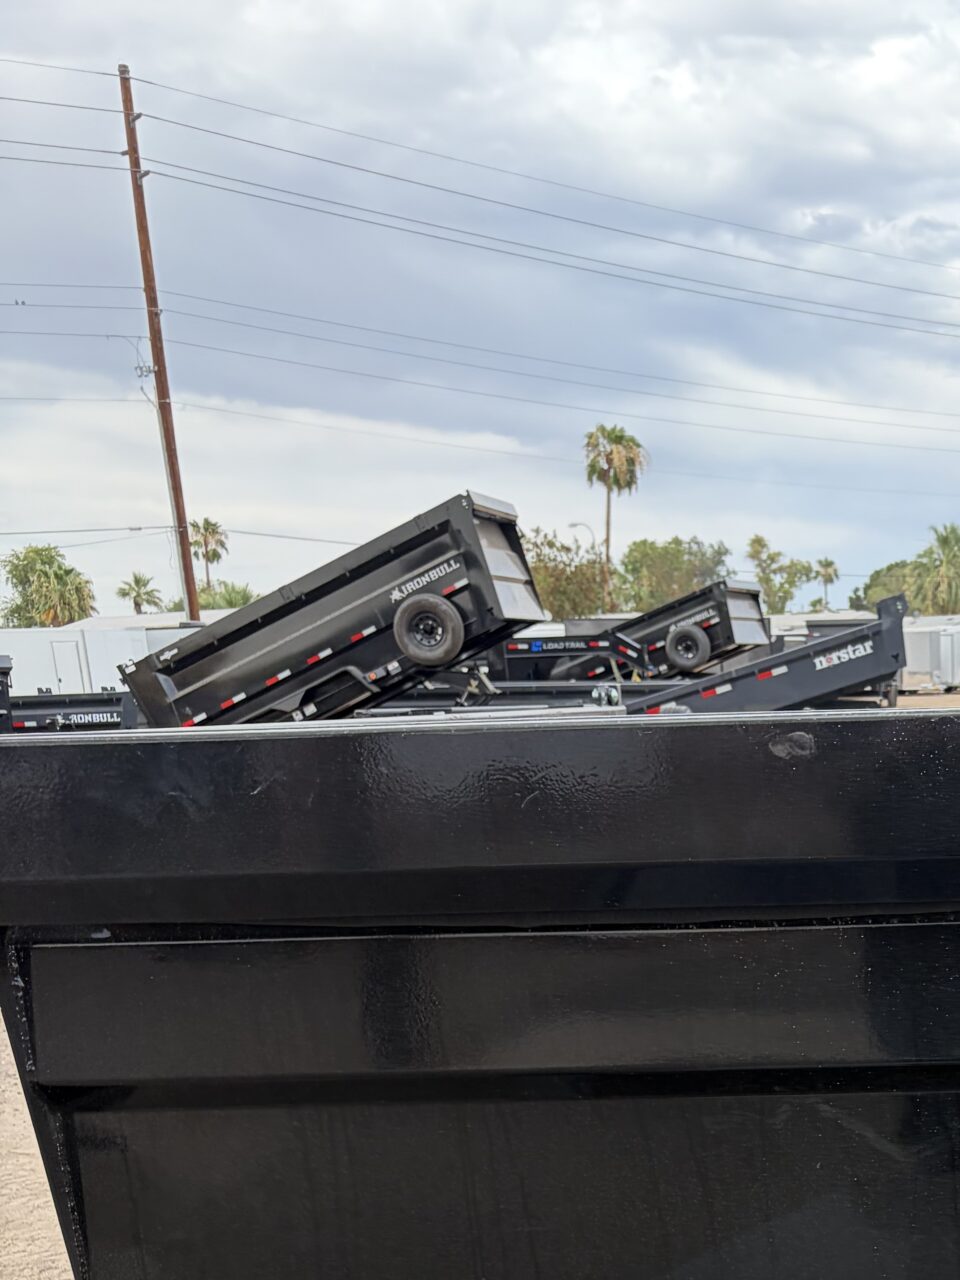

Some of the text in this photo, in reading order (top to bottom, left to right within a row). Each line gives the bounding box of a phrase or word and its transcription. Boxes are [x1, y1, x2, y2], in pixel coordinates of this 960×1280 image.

[401, 560, 460, 597] IRONBULL
[813, 640, 873, 671] norstar
[69, 713, 120, 723] RONBULL
